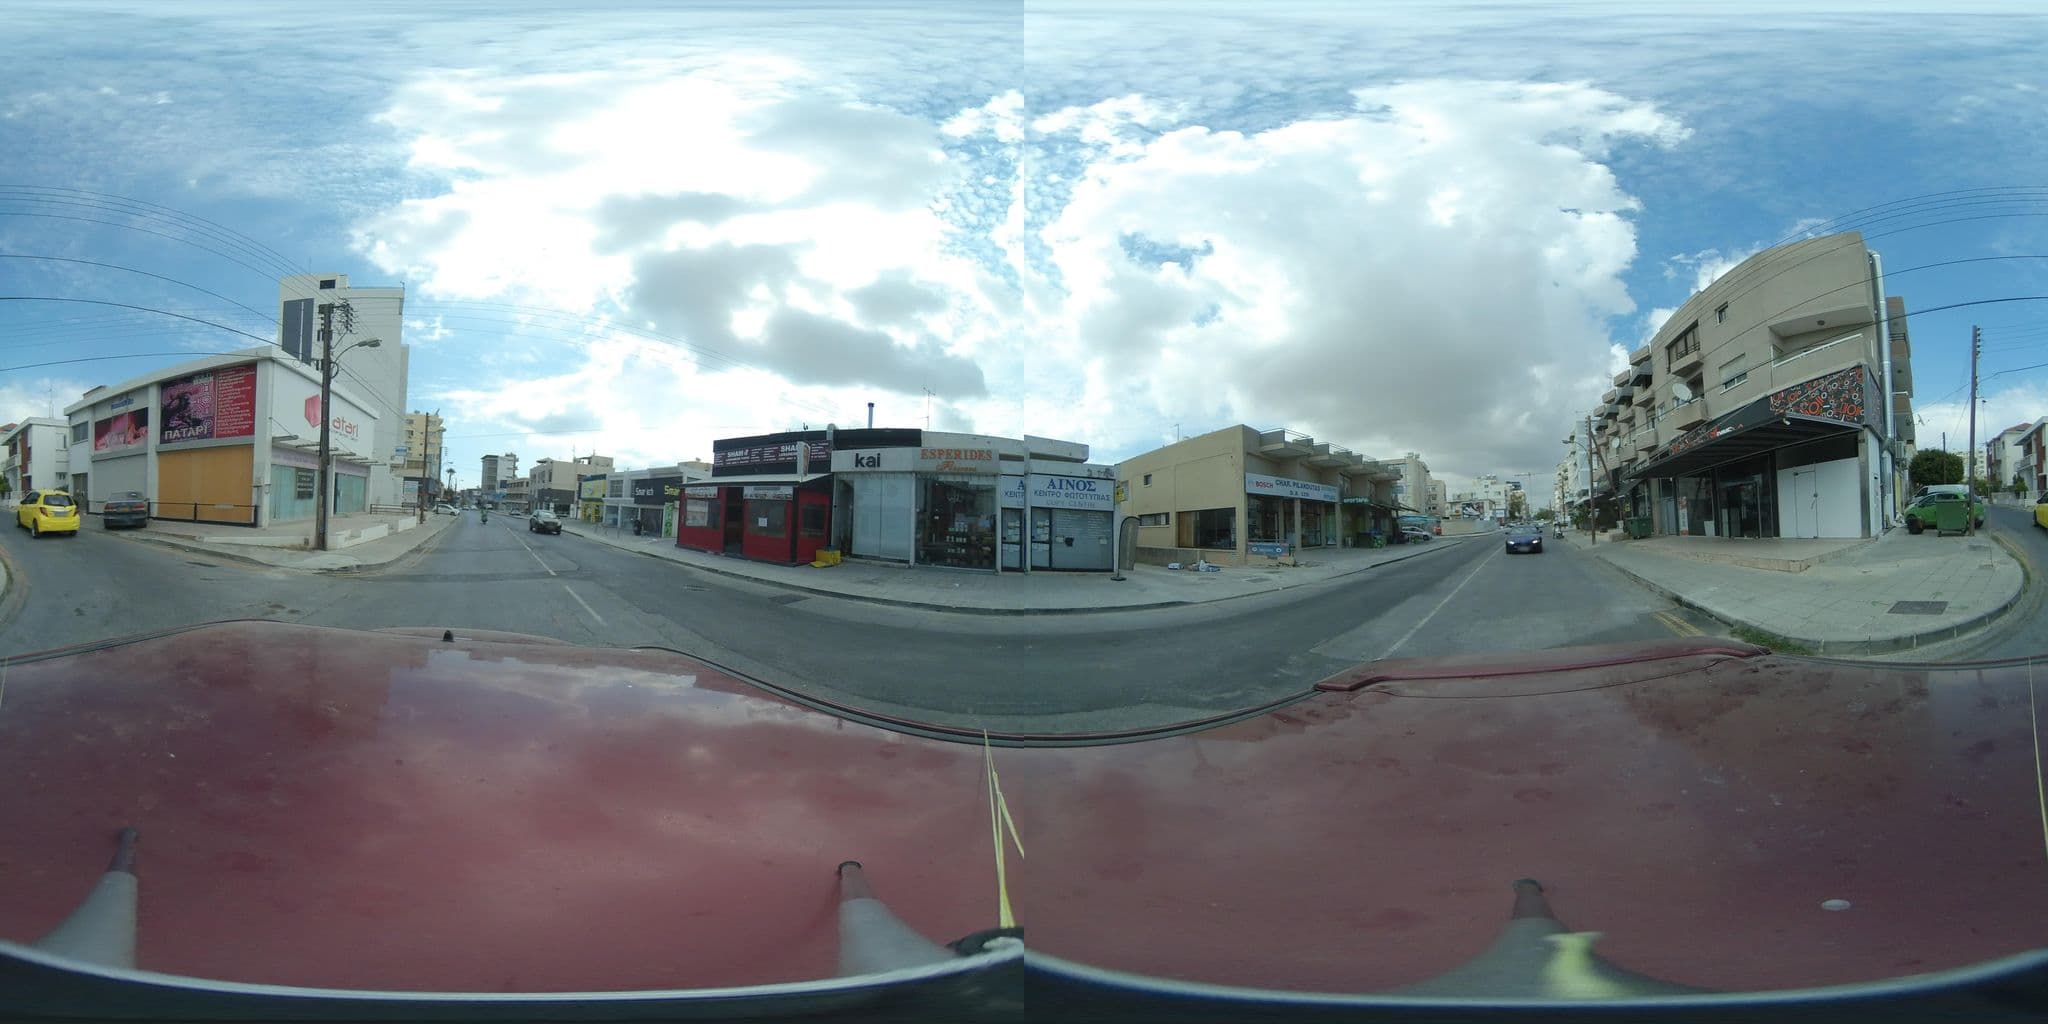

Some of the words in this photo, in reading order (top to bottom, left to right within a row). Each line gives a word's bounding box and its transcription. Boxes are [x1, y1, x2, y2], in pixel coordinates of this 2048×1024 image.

[855, 453, 881, 468] kai
[920, 448, 992, 461] ESPERIDES
[1255, 480, 1274, 489] BOSCH
